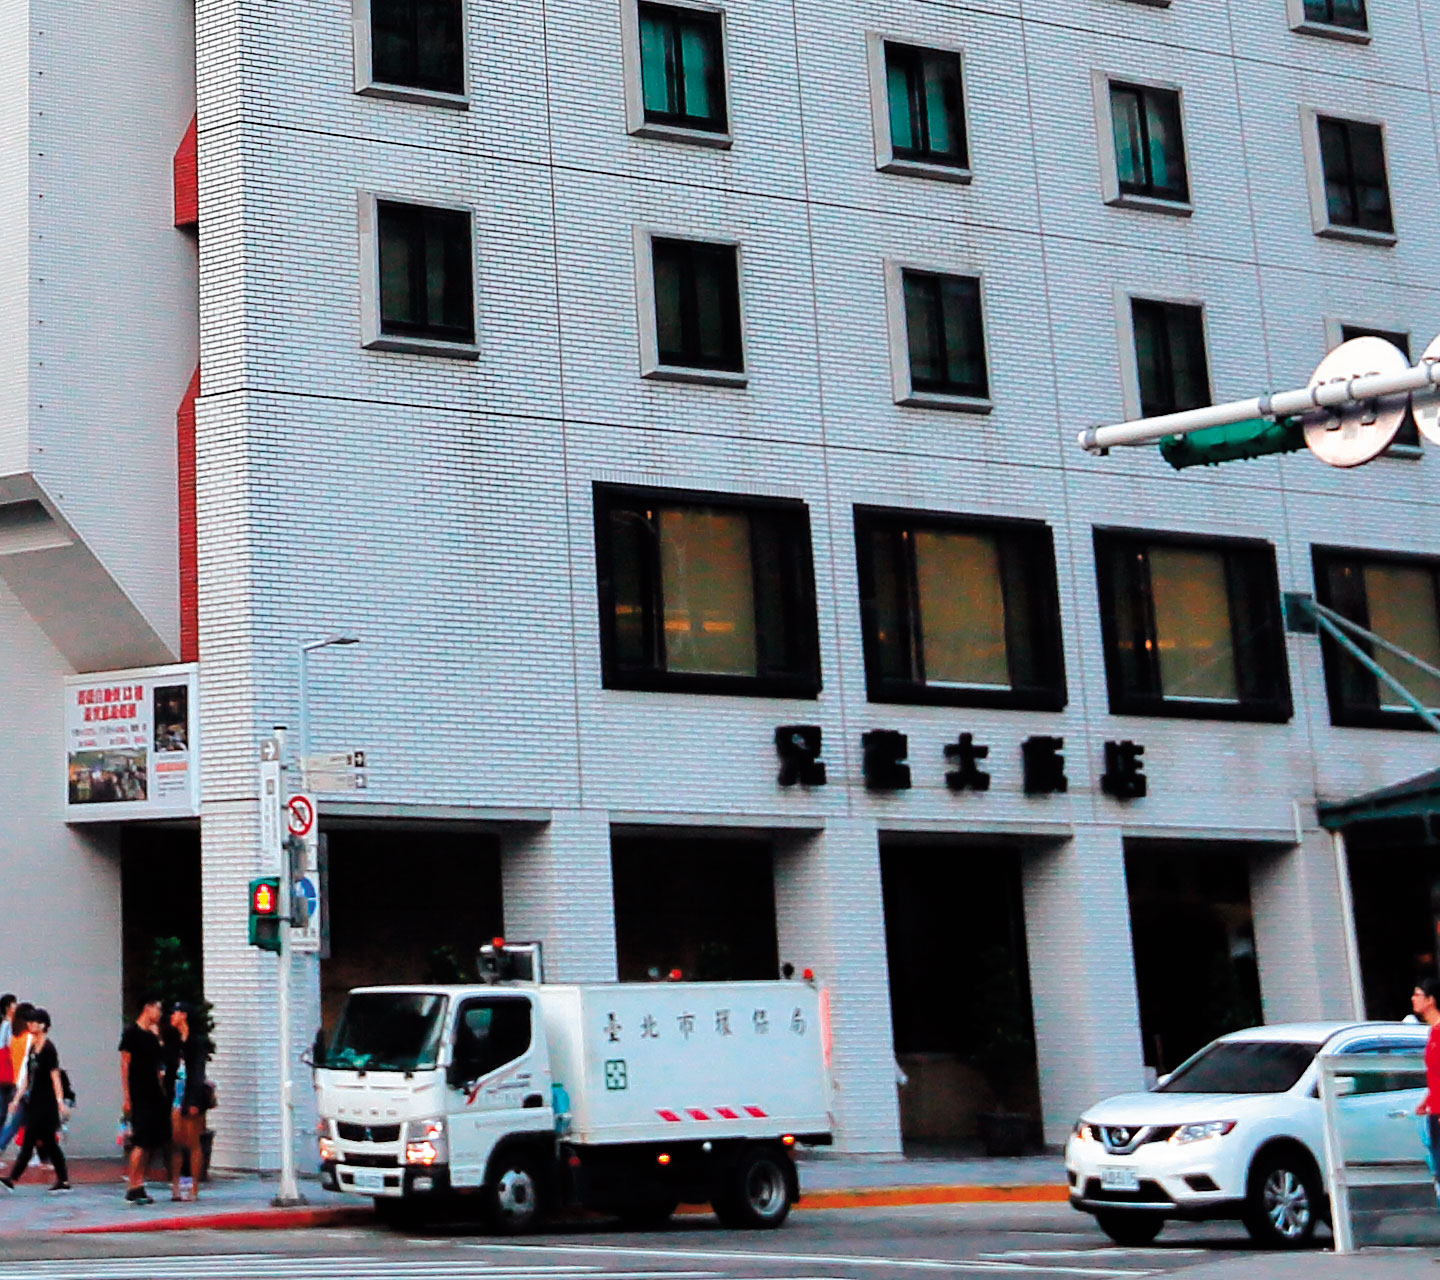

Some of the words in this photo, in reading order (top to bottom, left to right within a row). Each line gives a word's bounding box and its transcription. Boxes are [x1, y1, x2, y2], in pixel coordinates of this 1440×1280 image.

[603, 1007, 808, 1043] 臺北市環保局
